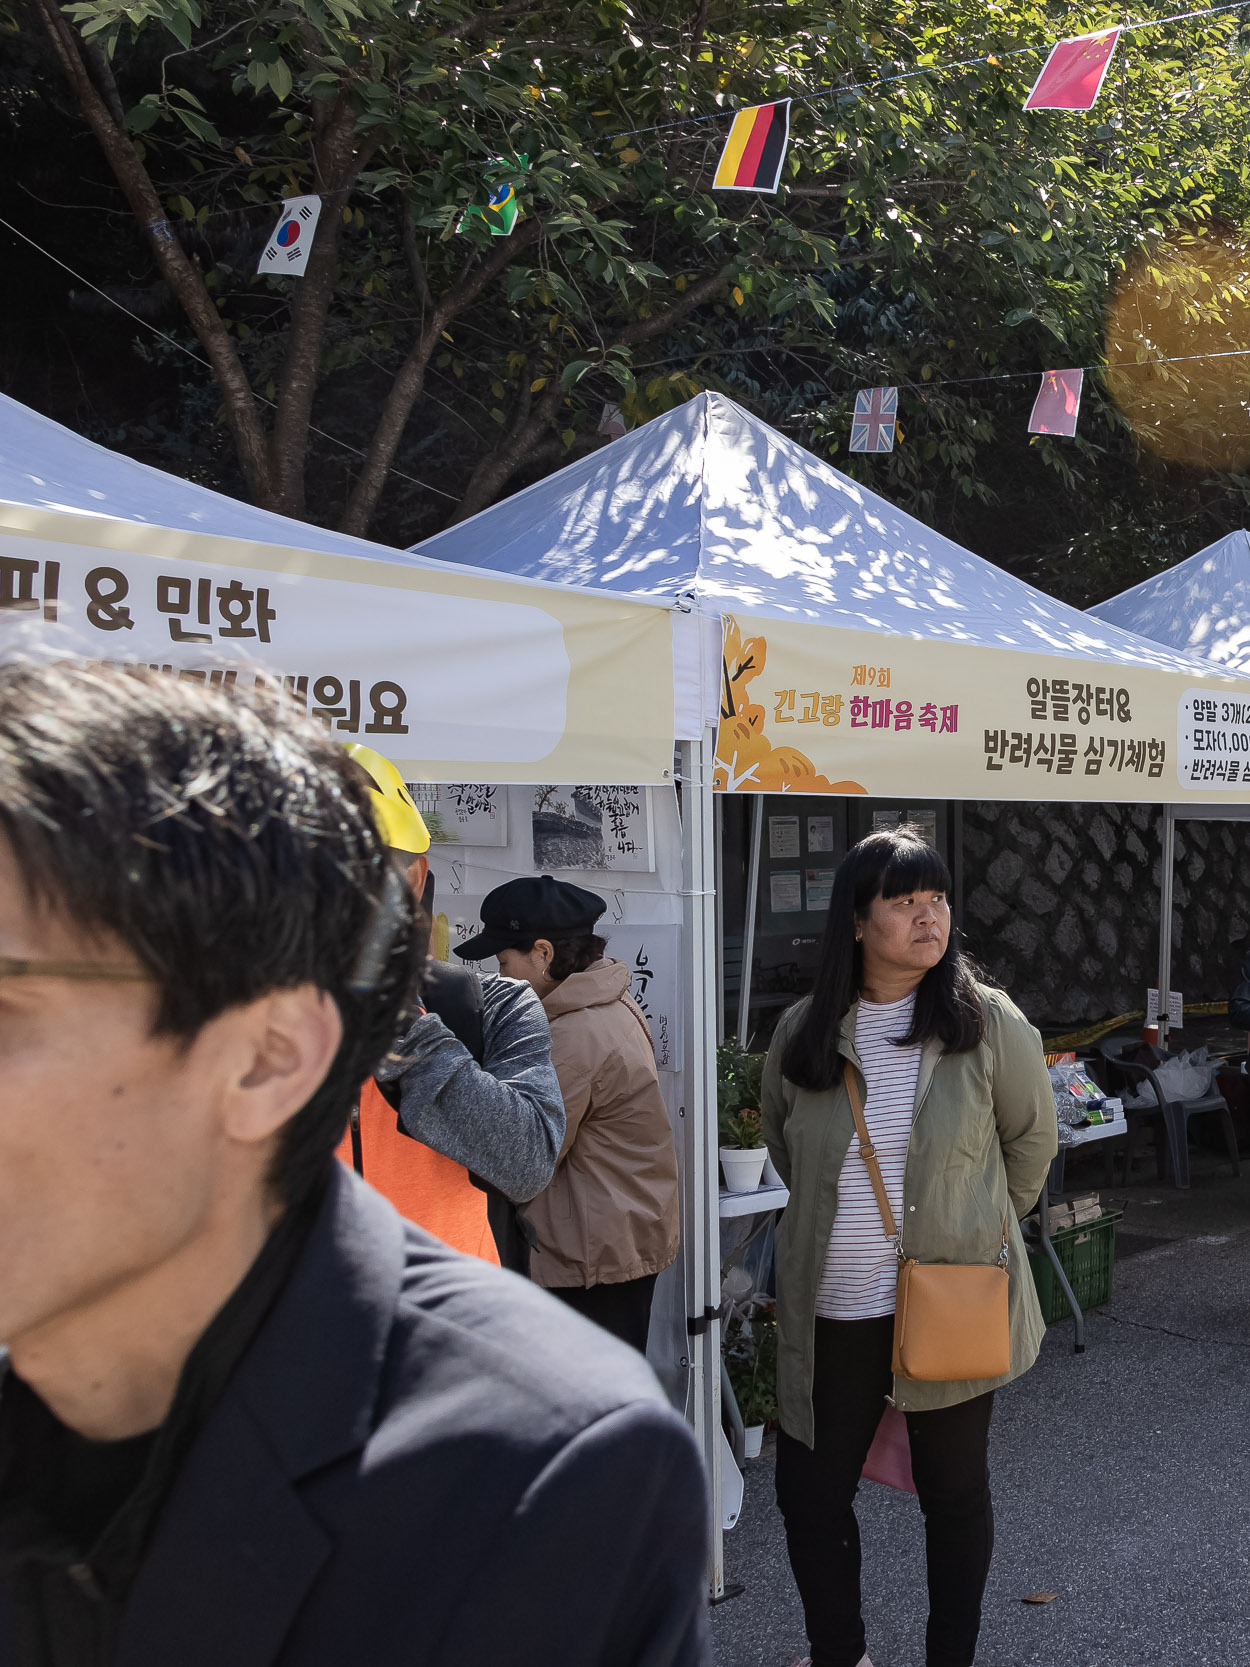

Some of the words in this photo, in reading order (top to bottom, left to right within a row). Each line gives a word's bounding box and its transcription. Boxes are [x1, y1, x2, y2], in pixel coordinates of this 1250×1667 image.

[85, 566, 135, 631] &
[157, 575, 276, 643] 민화
[851, 664, 891, 688] 제9회
[773, 689, 845, 727] 긴고랑
[850, 695, 915, 732] 한마음
[918, 703, 959, 734] 축제
[1026, 677, 1132, 725] 알뜰장터&
[1193, 699, 1217, 723] 양말
[984, 729, 1078, 775] 반려식물
[1083, 735, 1166, 778] 심기체험
[1190, 758, 1240, 782] 반려식물
